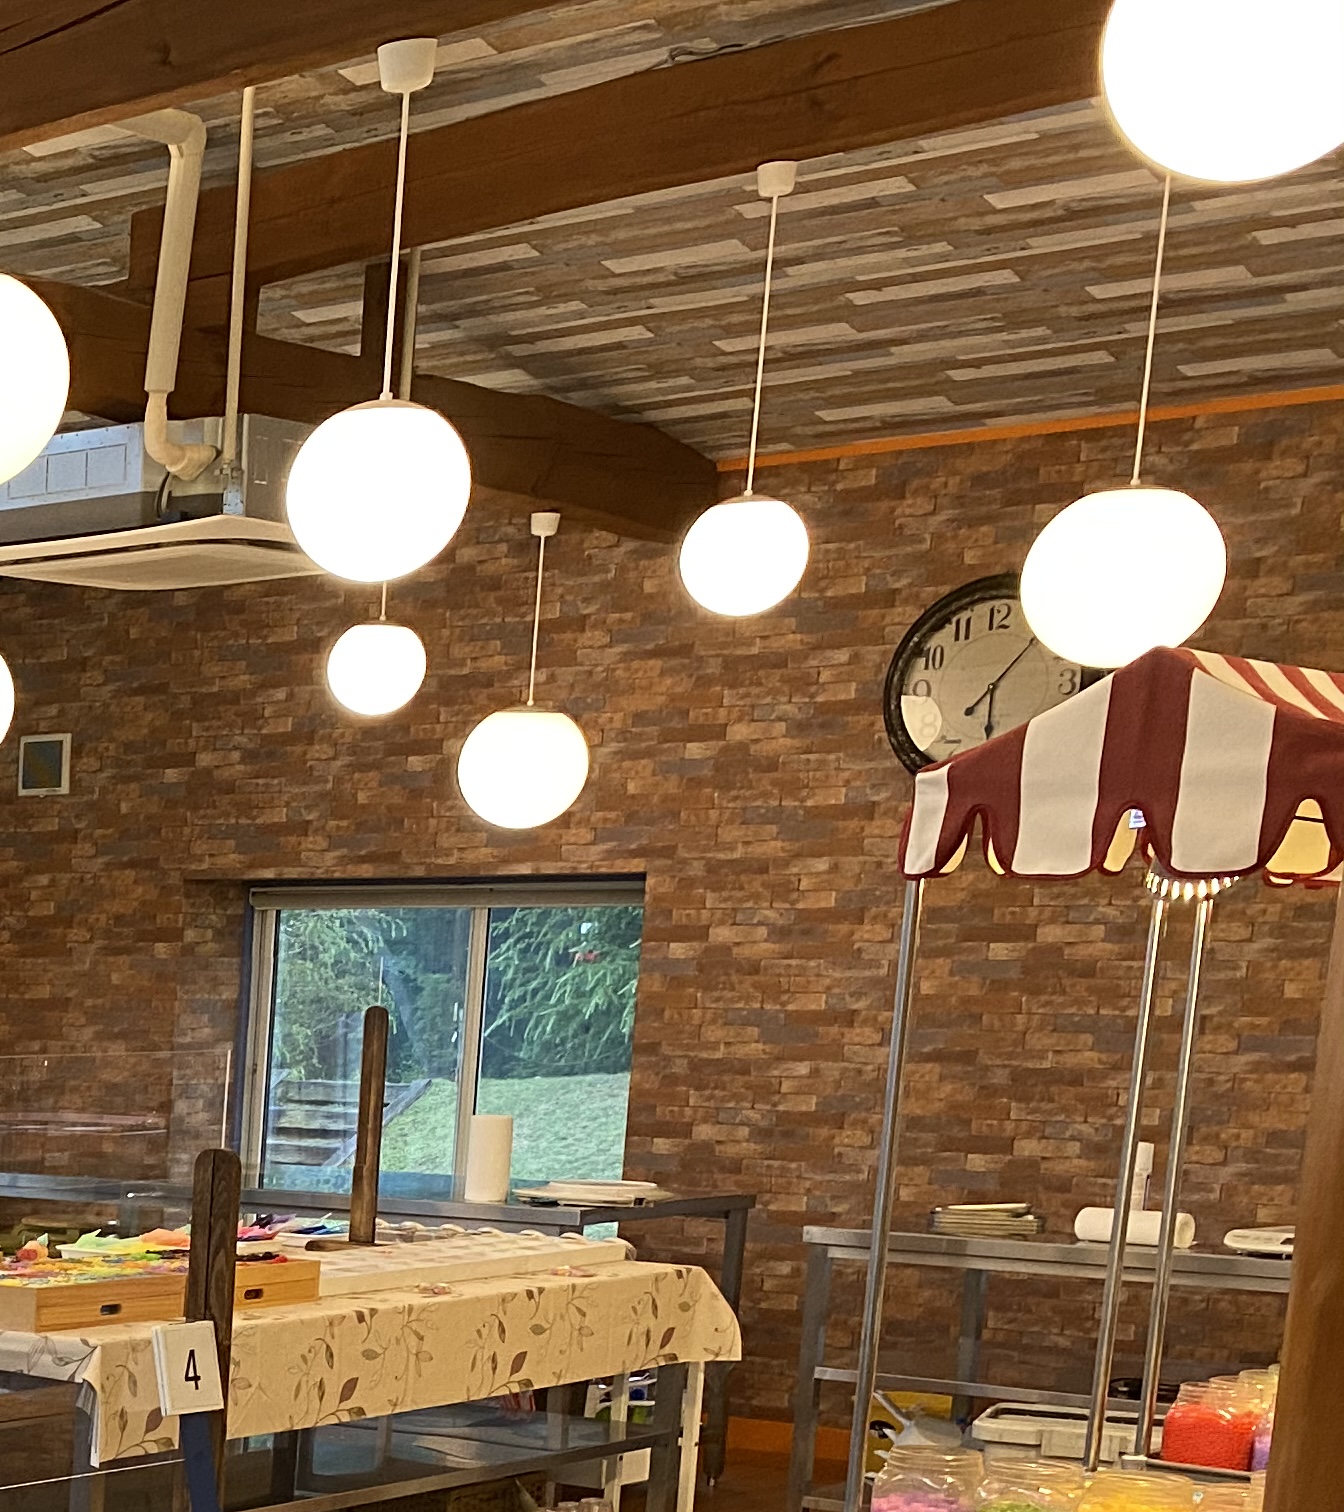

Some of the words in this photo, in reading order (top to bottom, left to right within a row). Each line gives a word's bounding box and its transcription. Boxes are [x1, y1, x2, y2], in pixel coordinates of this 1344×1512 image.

[953, 615, 972, 642] 11
[988, 603, 1012, 631] 12
[912, 678, 932, 704] 9
[1057, 668, 1077, 695] 3
[918, 711, 937, 738] 8
[184, 1348, 201, 1391] 4
